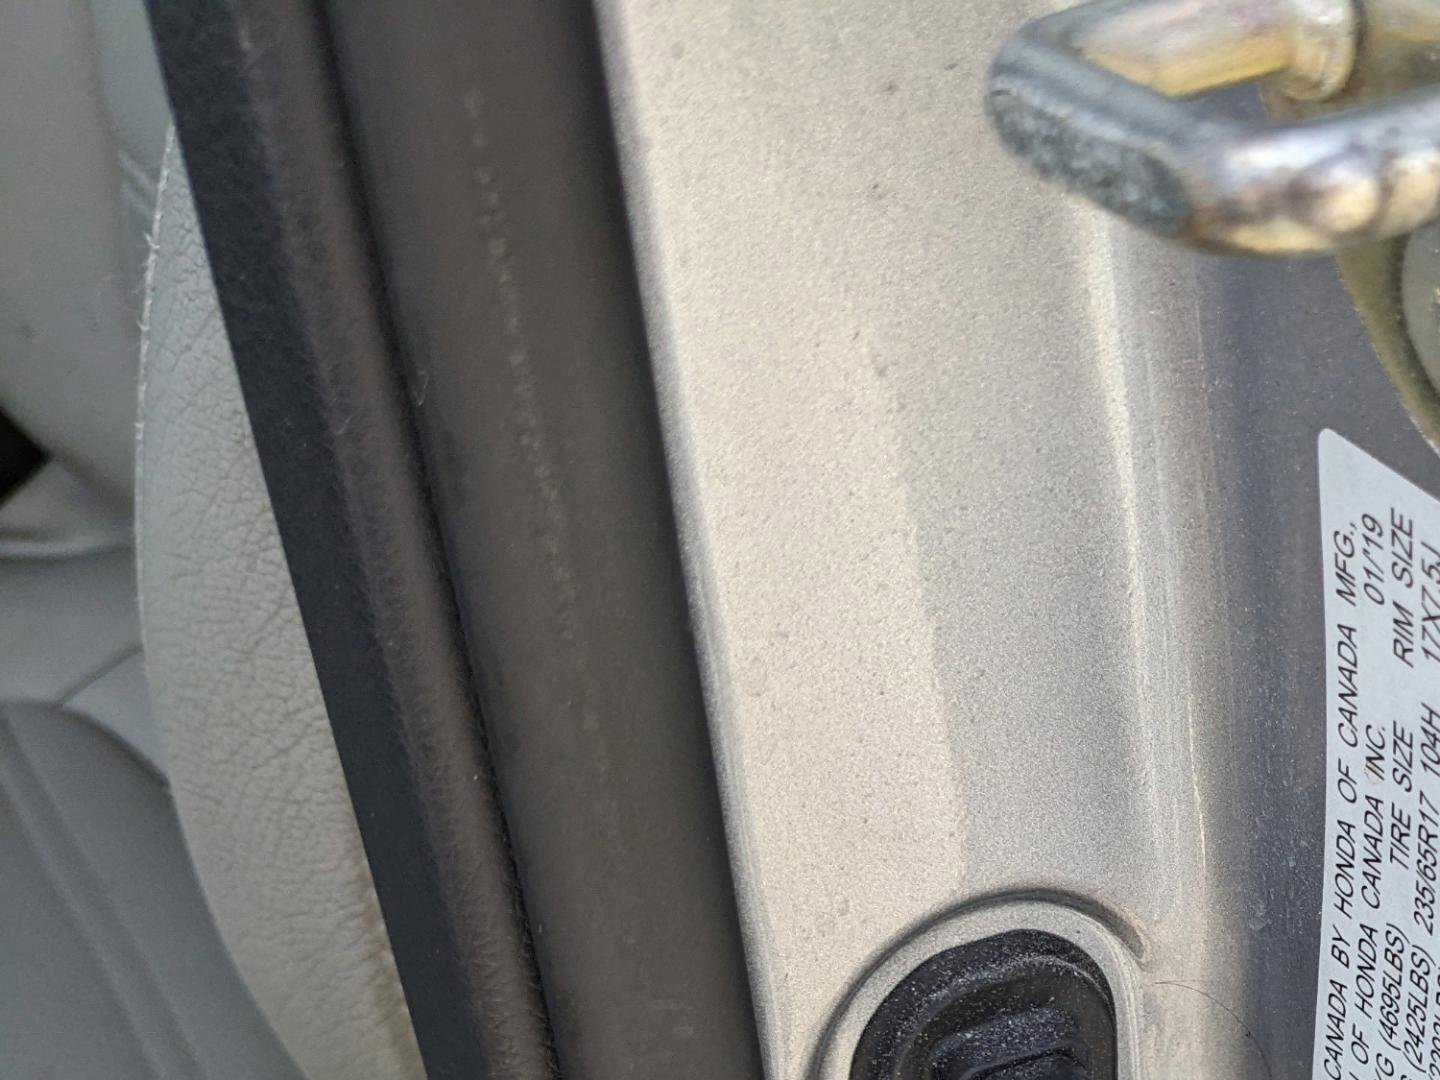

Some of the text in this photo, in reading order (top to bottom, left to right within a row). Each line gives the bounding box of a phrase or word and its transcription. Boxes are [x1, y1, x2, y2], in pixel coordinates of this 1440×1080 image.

[1390, 507, 1414, 589] SIZE
[1392, 600, 1414, 668] RIM
[1336, 623, 1359, 748] CANADA
[1337, 757, 1358, 804] OF
[1365, 724, 1386, 781] INC.
[1392, 720, 1414, 793] SIZE
[1333, 819, 1356, 920] HONDA
[1360, 794, 1384, 910] CANADA
[1389, 801, 1412, 870] TIRE
[1413, 789, 1440, 937] 235/65R17
[1330, 924, 1351, 969] BY
[1354, 923, 1379, 1020] HONDA
[1378, 922, 1408, 1051] (4695LBS)
[1350, 1023, 1370, 1065] OF
[1403, 944, 1435, 1074] (2425LBS)
